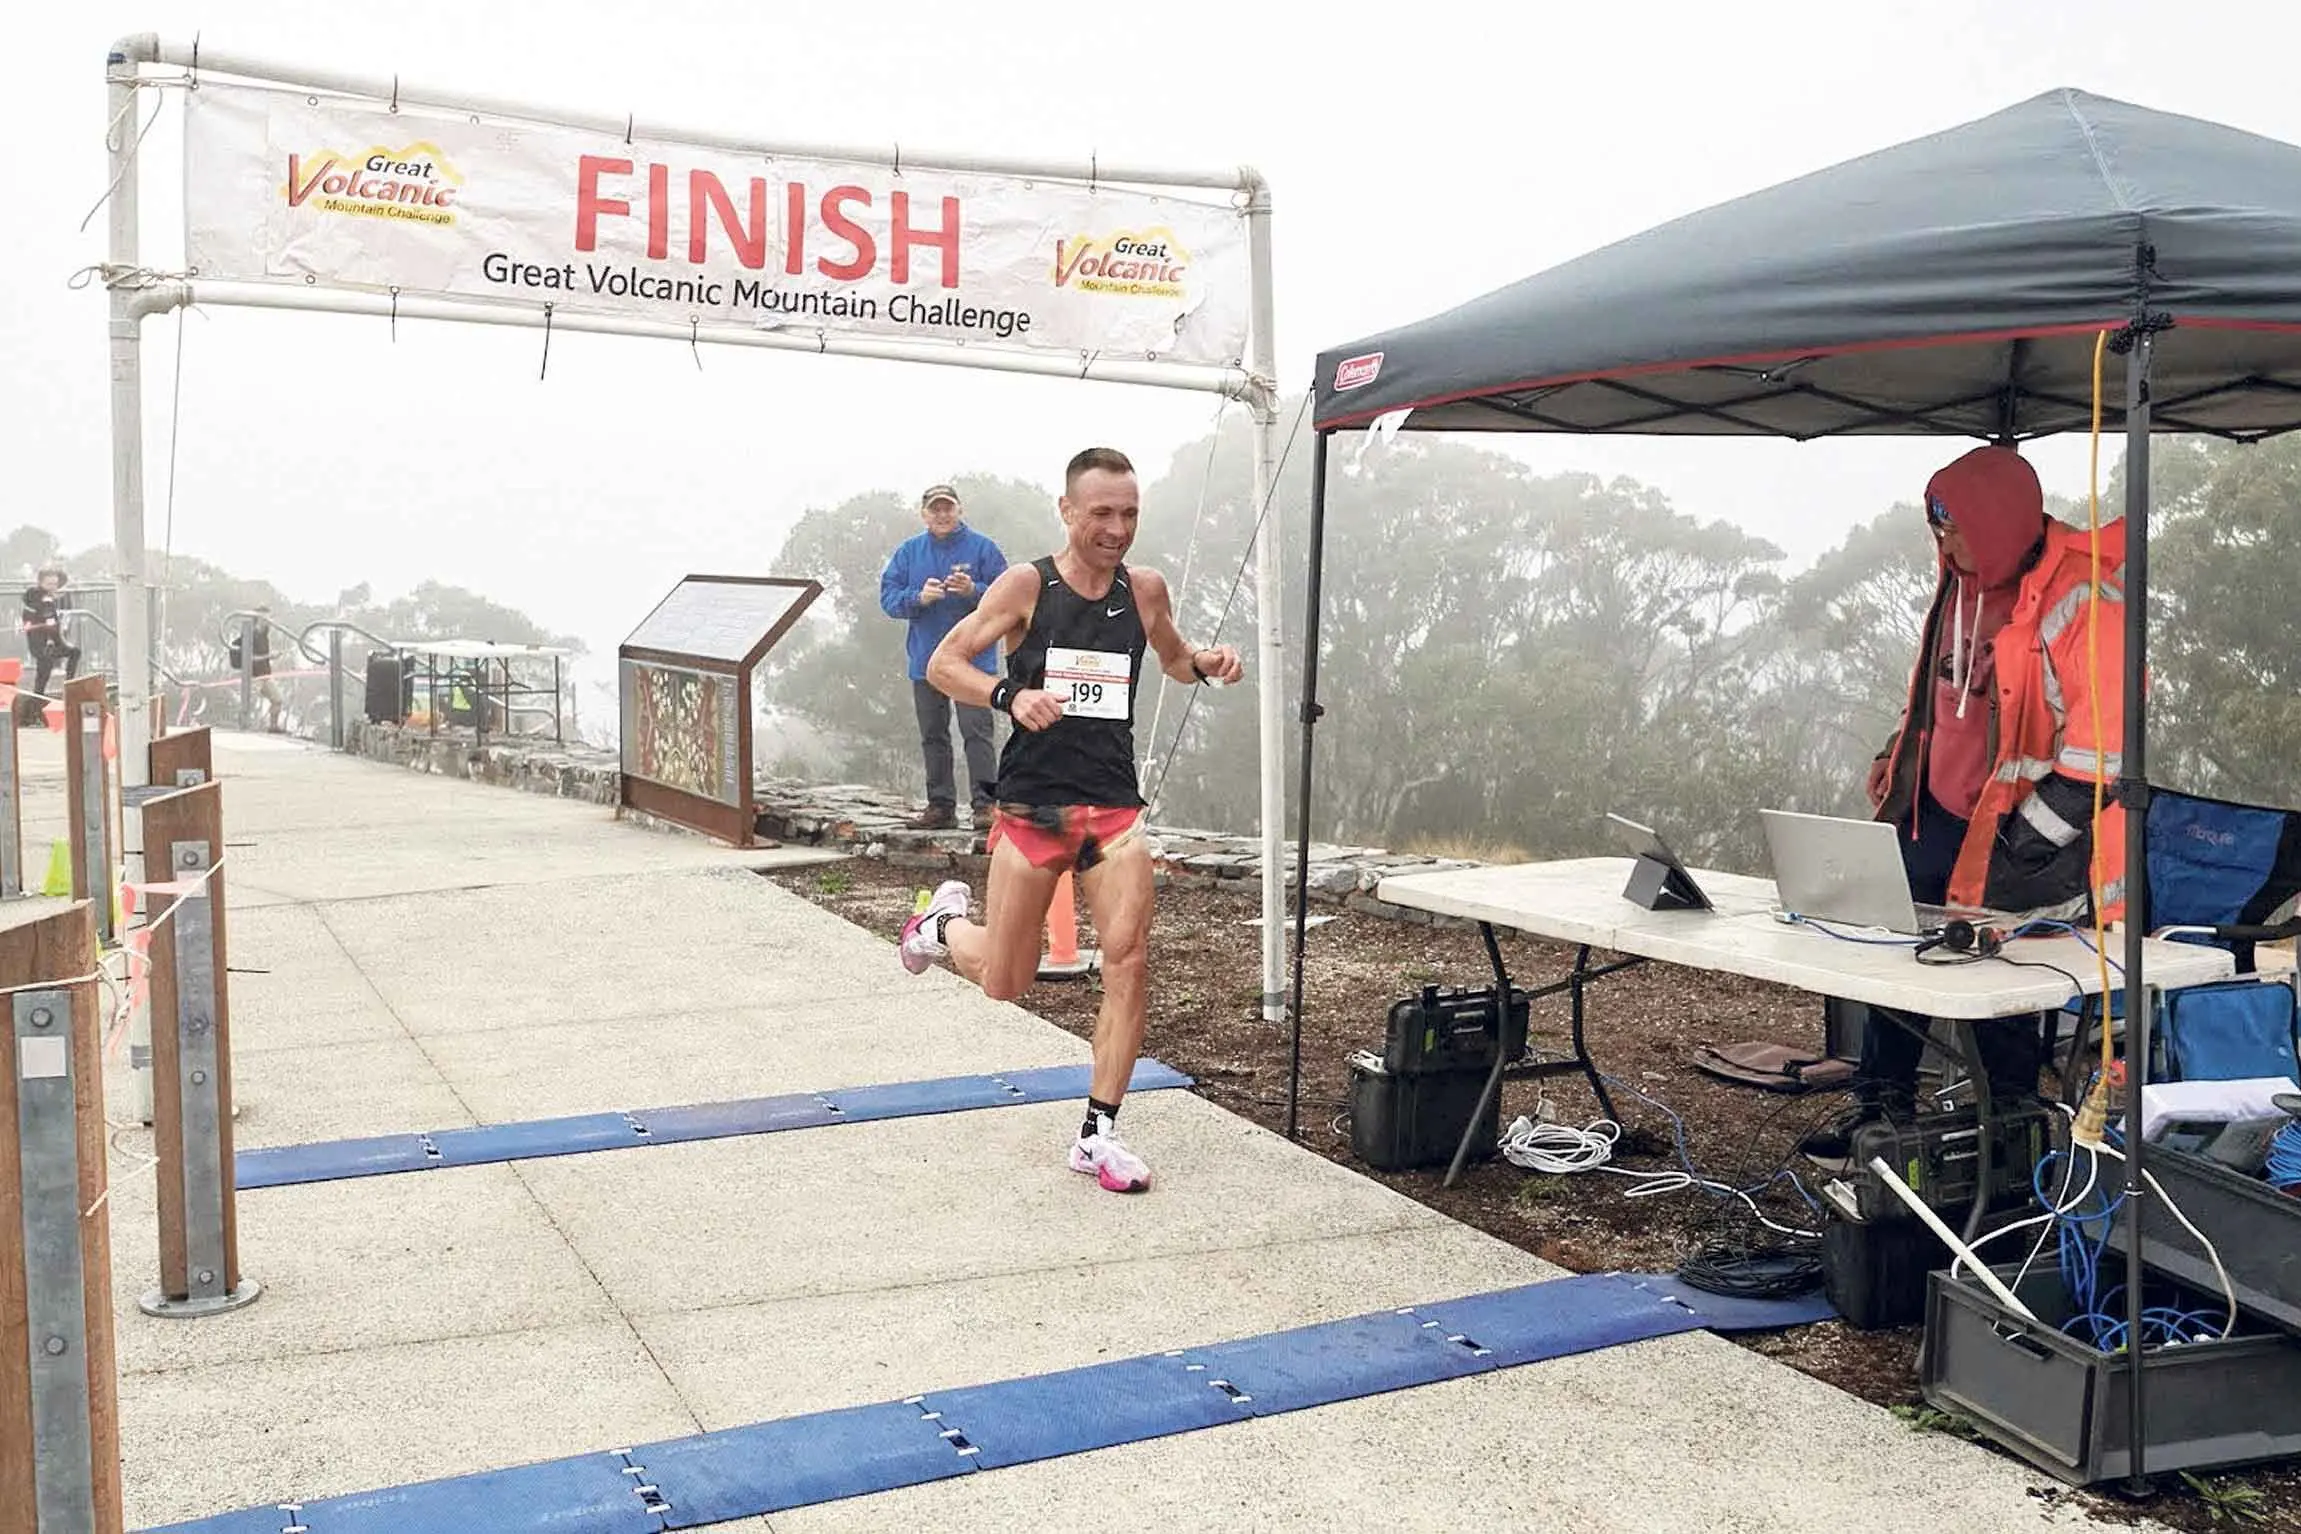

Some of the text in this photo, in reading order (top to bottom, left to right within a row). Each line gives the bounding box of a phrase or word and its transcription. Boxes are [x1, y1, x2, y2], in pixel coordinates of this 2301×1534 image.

[289, 153, 456, 207] Volcanic
[366, 154, 433, 178] Great
[324, 200, 451, 224] Mountain Challenge
[575, 154, 961, 289] FINISH
[1056, 239, 1185, 287] Volcanic
[1114, 237, 1167, 257] Great
[483, 253, 1031, 337] Great Volcanic Mountain Challenge
[1071, 682, 1103, 704] 199
